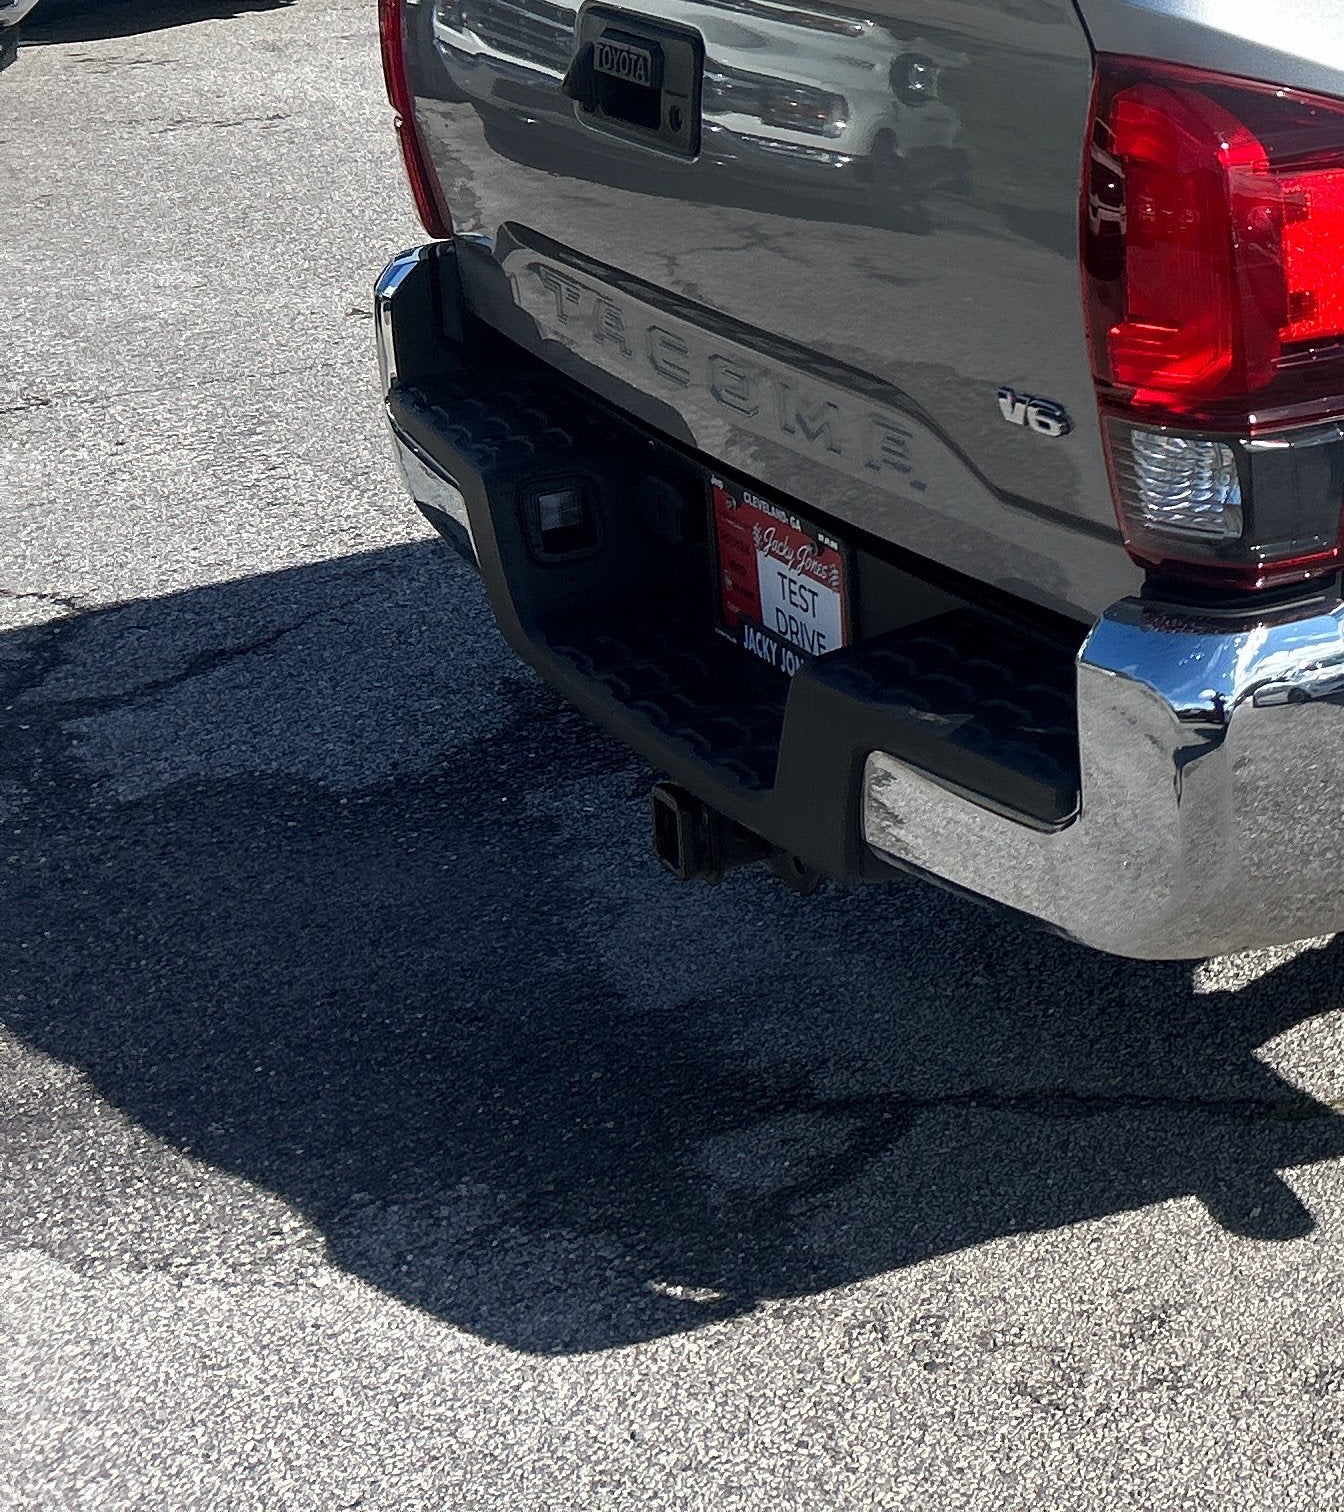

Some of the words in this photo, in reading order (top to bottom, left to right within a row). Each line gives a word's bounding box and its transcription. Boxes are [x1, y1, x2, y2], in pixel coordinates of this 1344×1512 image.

[594, 42, 646, 84] TOYOTA
[527, 262, 927, 492] TACOMA
[997, 385, 1071, 438] V6
[790, 515, 802, 532] GA
[763, 527, 795, 570] Jacky
[796, 544, 828, 580] Jones
[777, 571, 819, 618] TEST
[743, 624, 778, 667] JACKY
[776, 607, 827, 654] DRIVE
